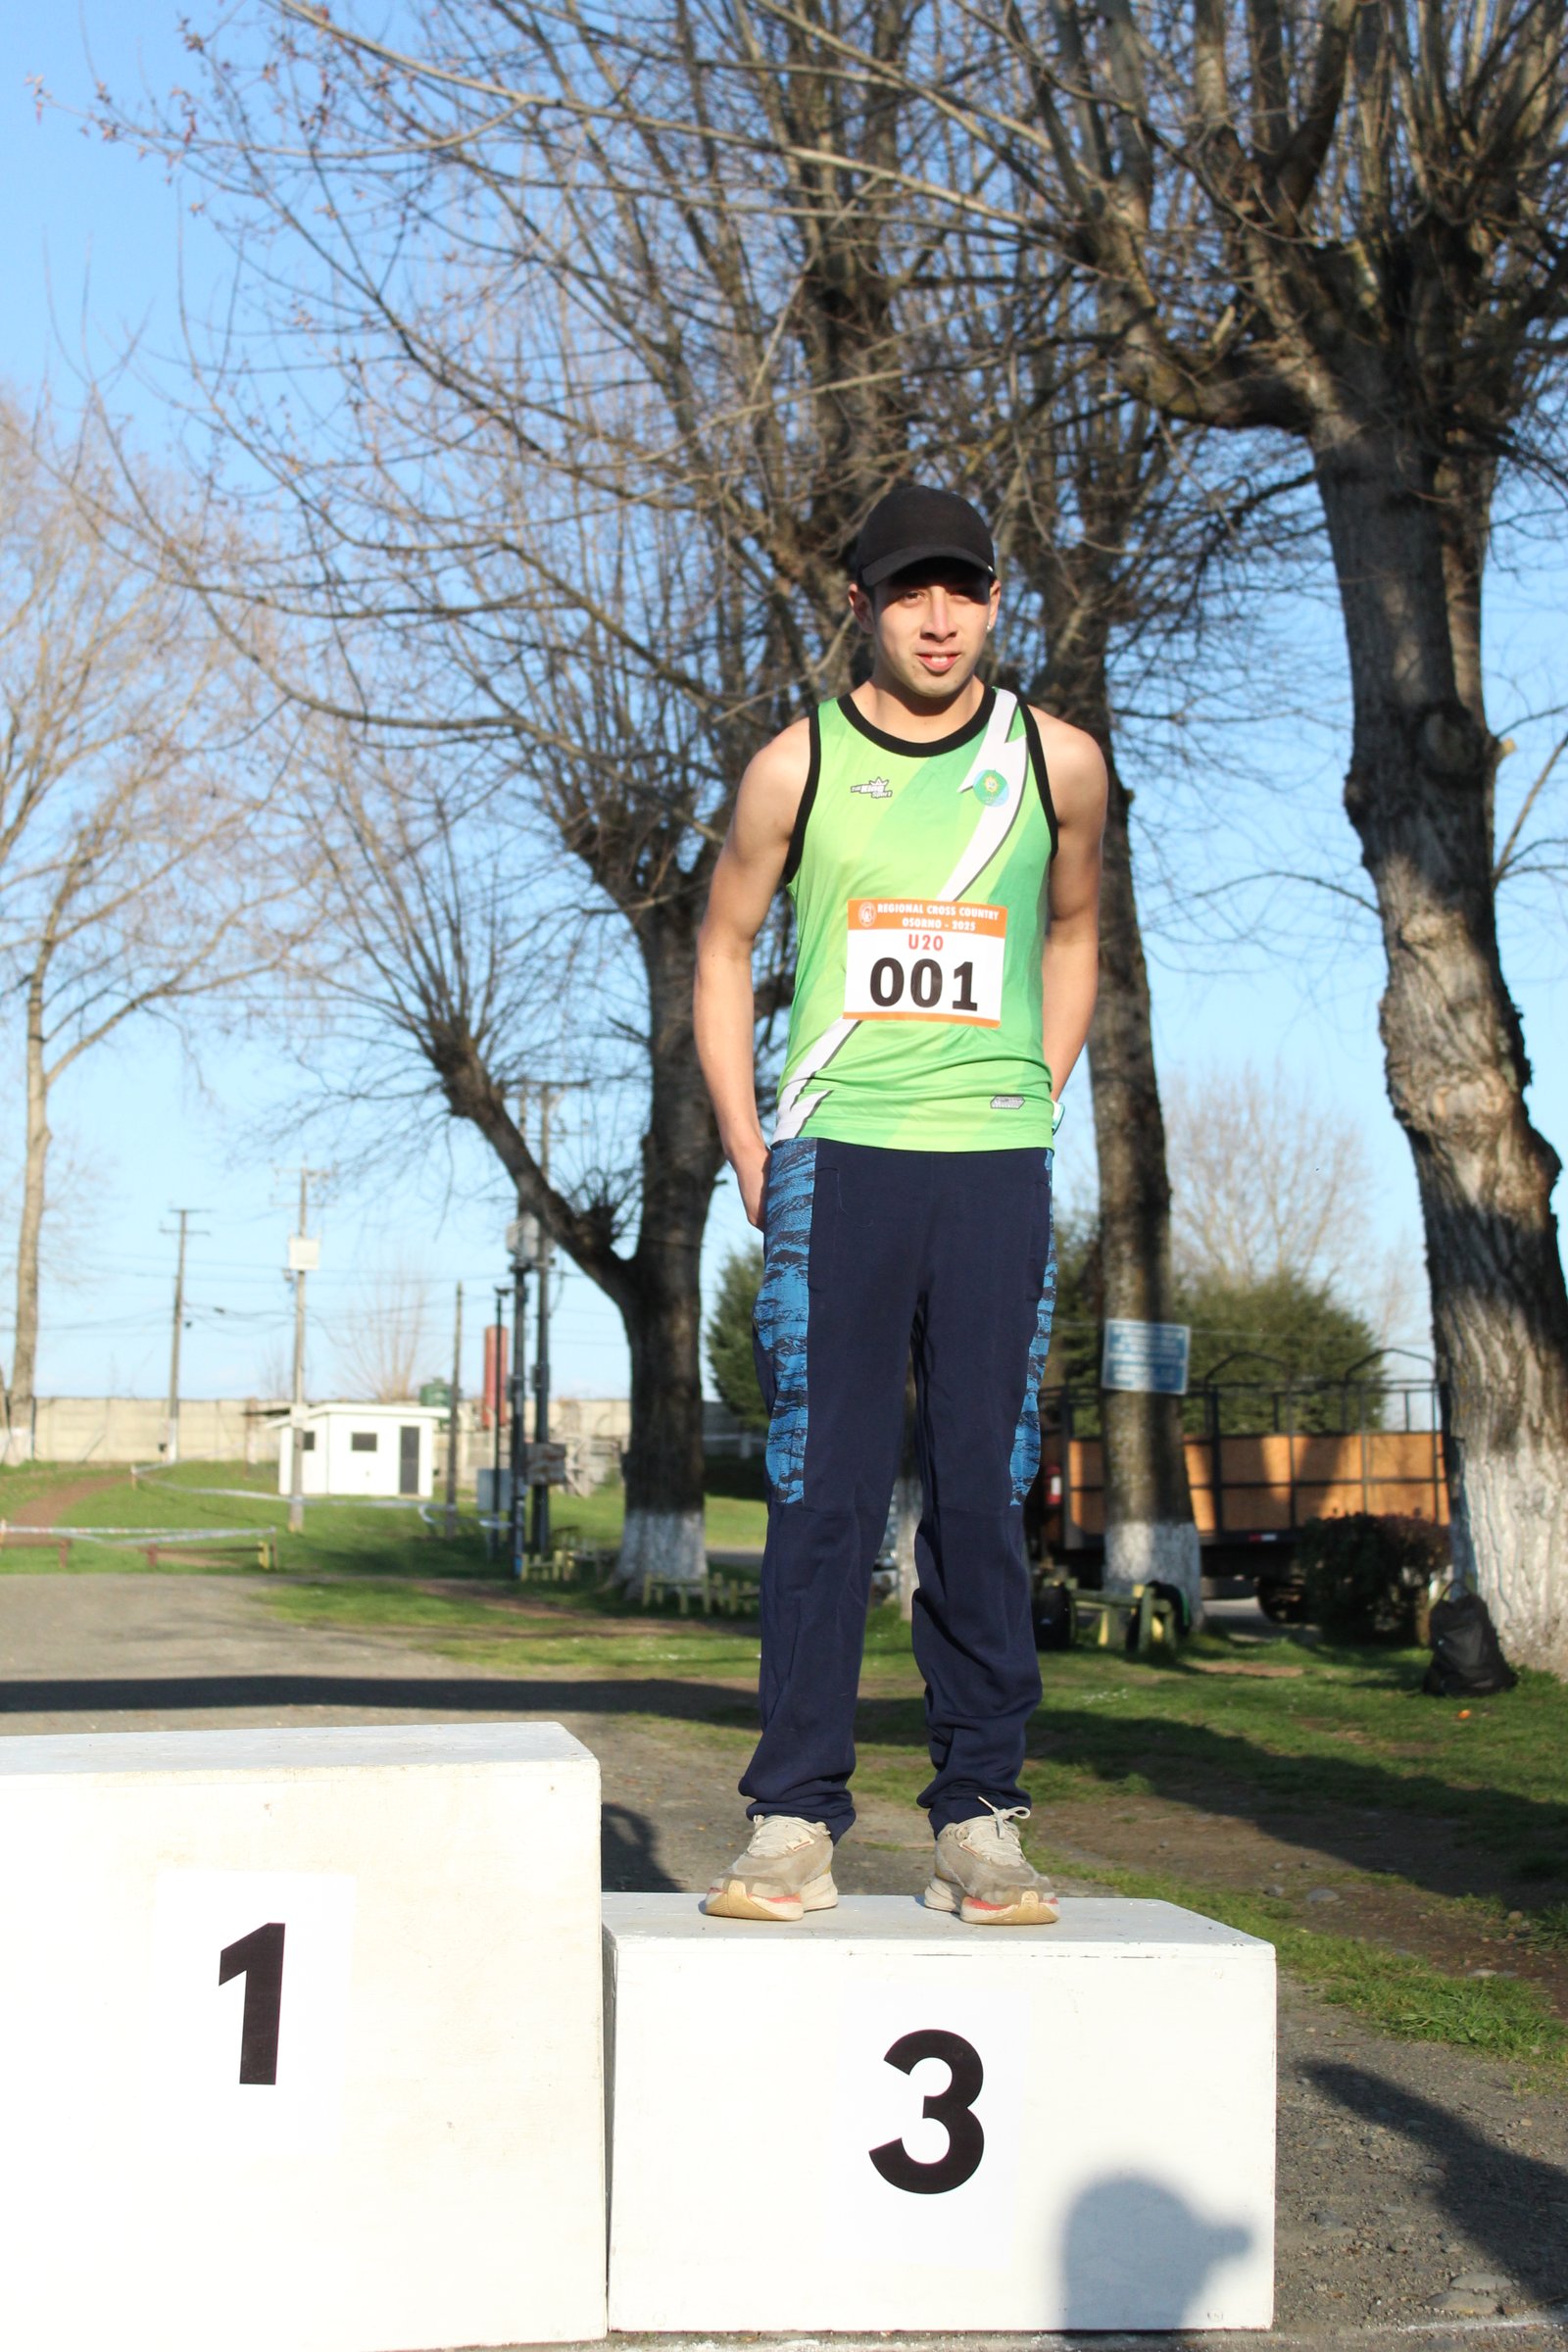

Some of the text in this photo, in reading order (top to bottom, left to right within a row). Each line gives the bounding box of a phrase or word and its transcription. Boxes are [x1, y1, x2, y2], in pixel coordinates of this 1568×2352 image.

[877, 903, 1000, 921] REGIONAL CROSS COUNTRY
[902, 917, 942, 929] OSORNO
[952, 919, 976, 931] 2025
[907, 934, 944, 951] U20
[869, 956, 978, 1011] 001
[219, 1923, 286, 2085] 1
[868, 2029, 985, 2195] 3
